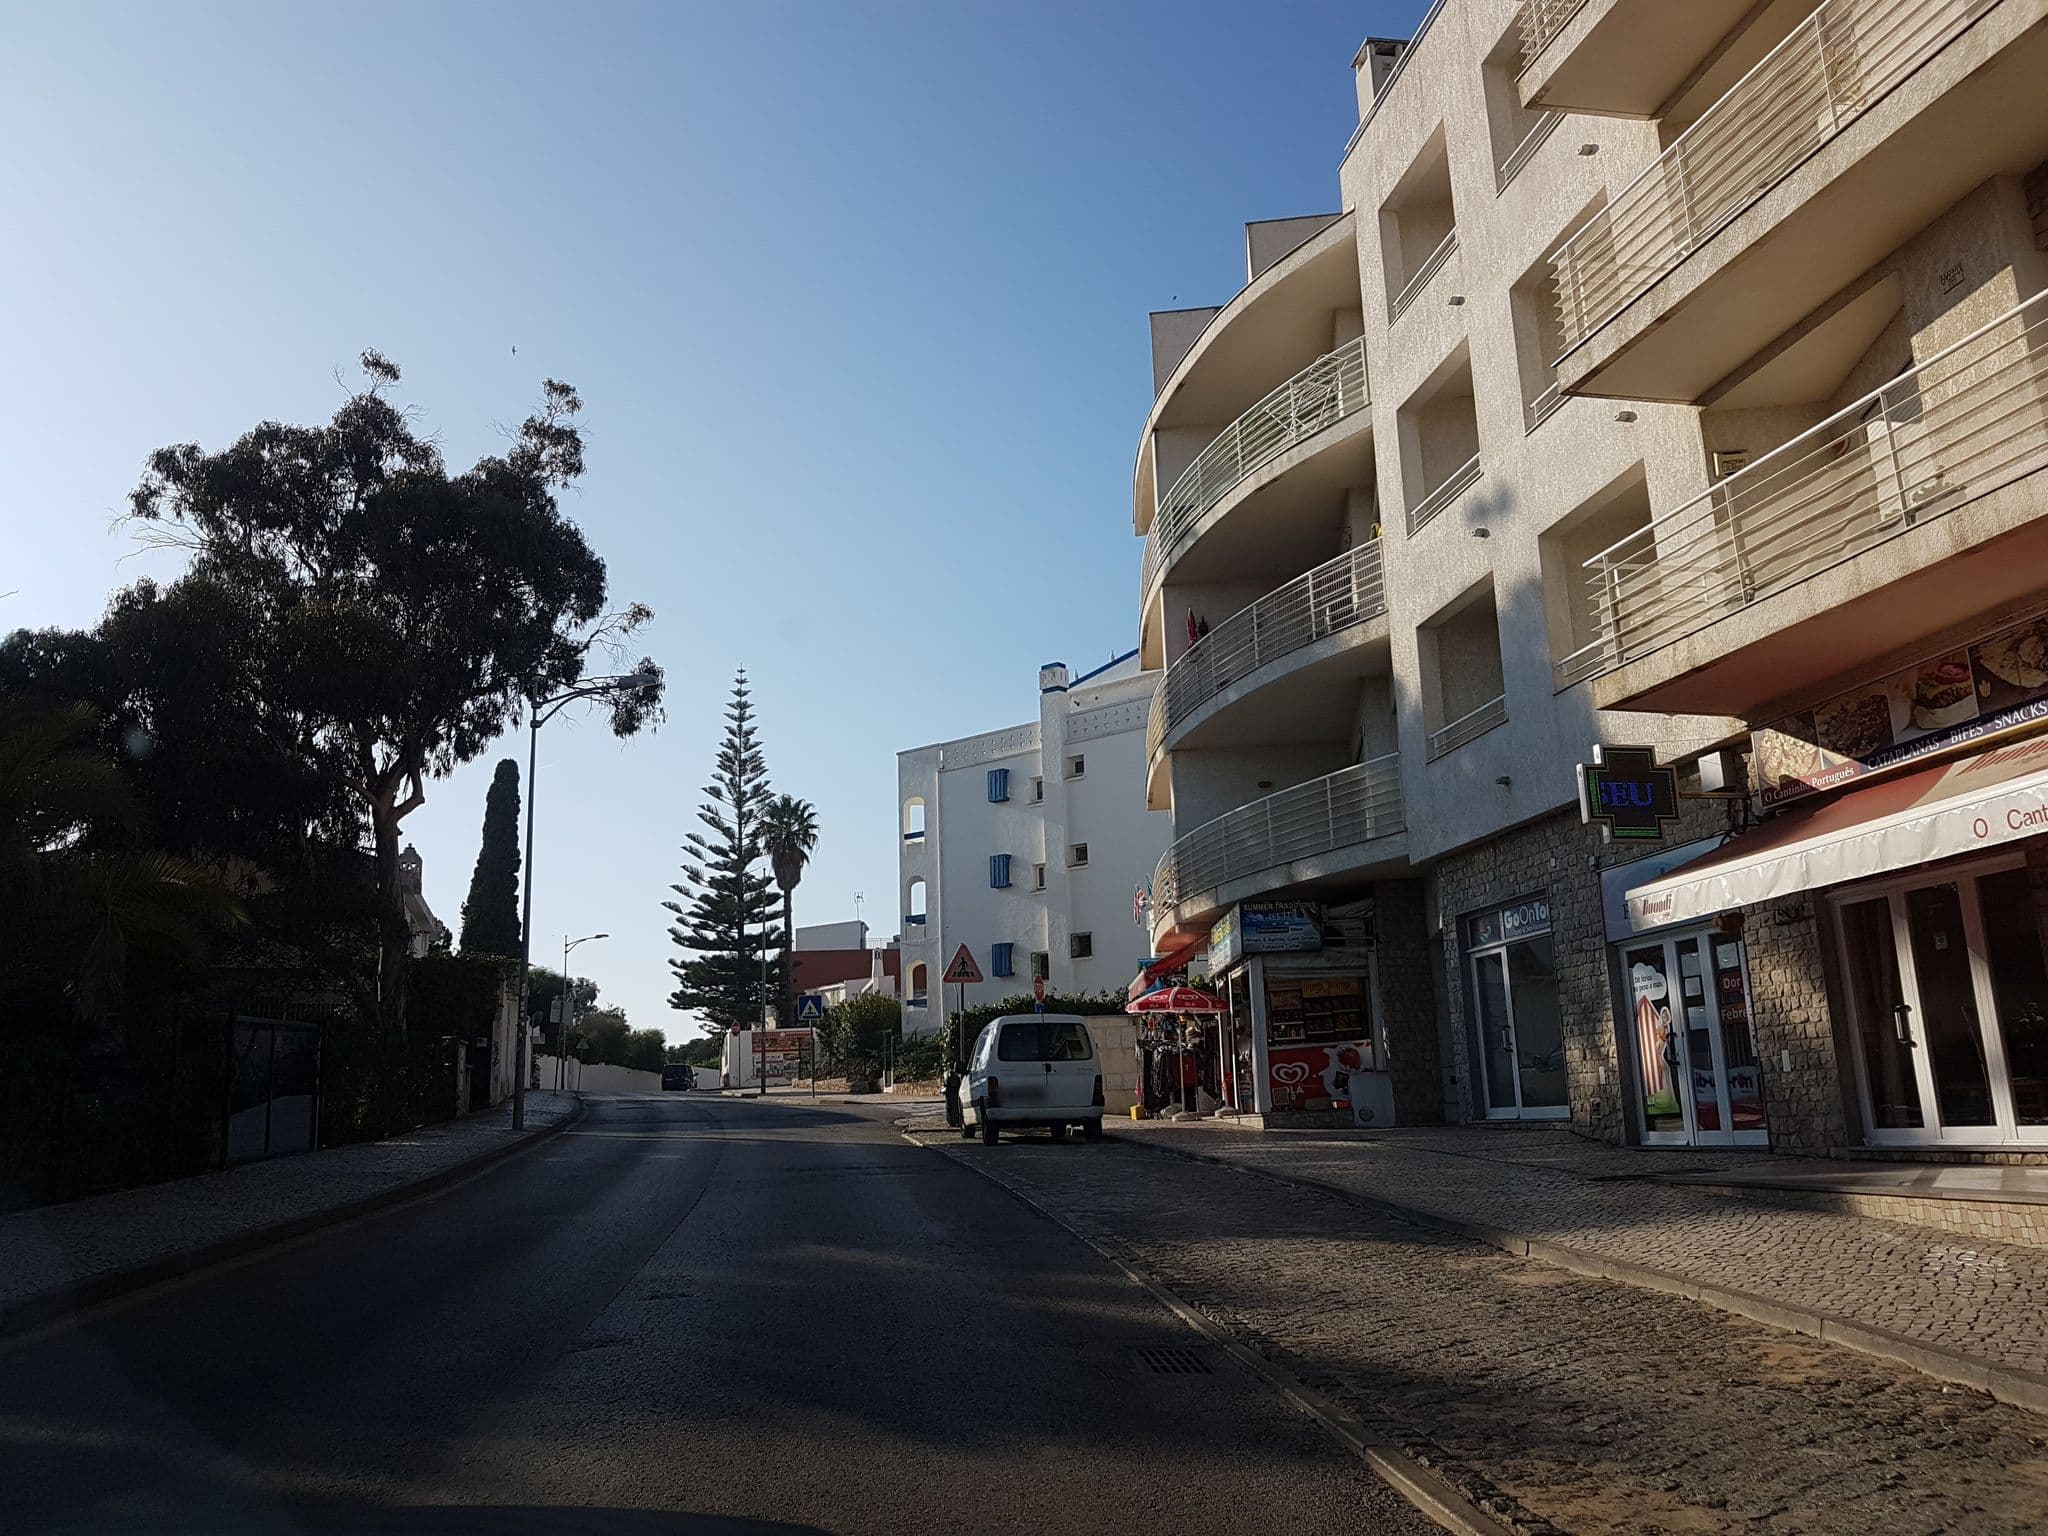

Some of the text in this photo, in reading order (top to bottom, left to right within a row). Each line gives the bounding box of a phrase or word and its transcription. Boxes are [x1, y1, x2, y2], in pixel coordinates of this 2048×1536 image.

[1867, 700, 2048, 770] CATAPLANAS BIFES SNACKS
[1764, 766, 1855, 803] O Cantinho Português
[1973, 803, 2048, 839] O Cant
